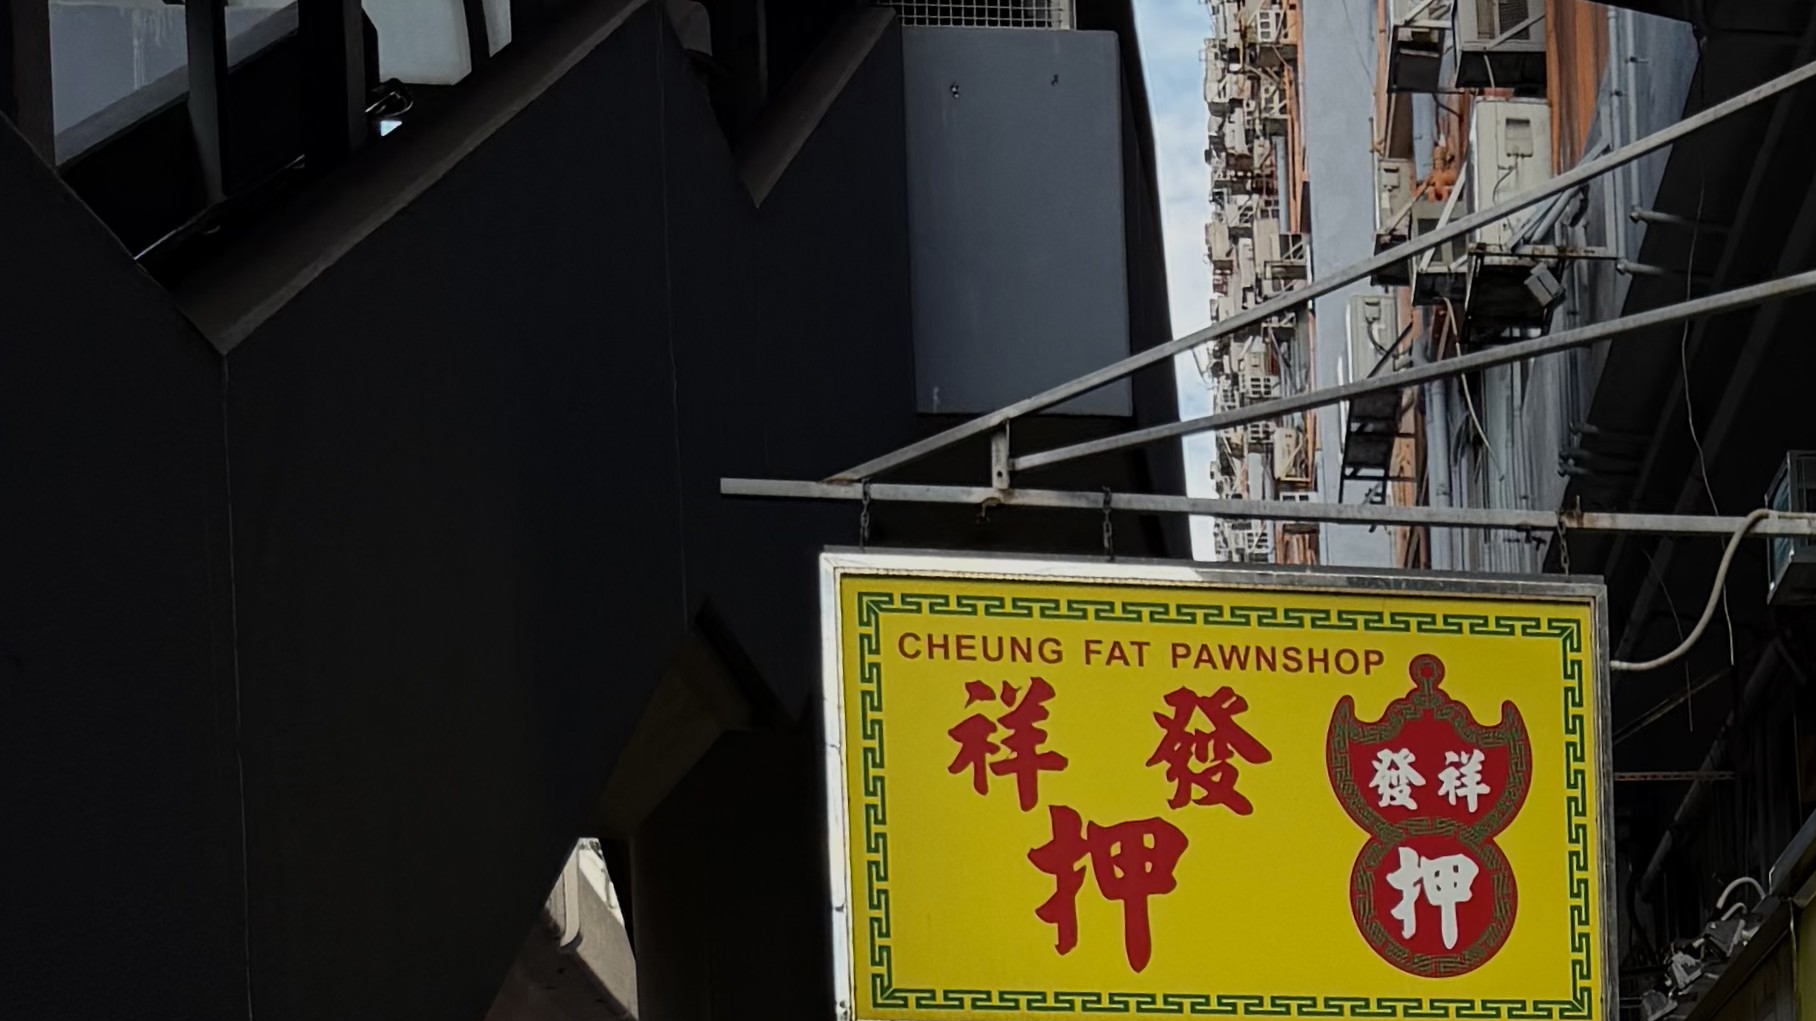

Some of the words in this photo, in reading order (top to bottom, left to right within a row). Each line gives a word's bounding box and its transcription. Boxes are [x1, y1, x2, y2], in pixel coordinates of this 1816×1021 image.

[897, 632, 1064, 666] CHEUNG
[1083, 639, 1152, 668] FAT
[1171, 643, 1386, 677] PAWNSHOP
[1367, 747, 1492, 813] 發祥
[1027, 804, 1190, 974] 押
[1385, 846, 1480, 951] 押
